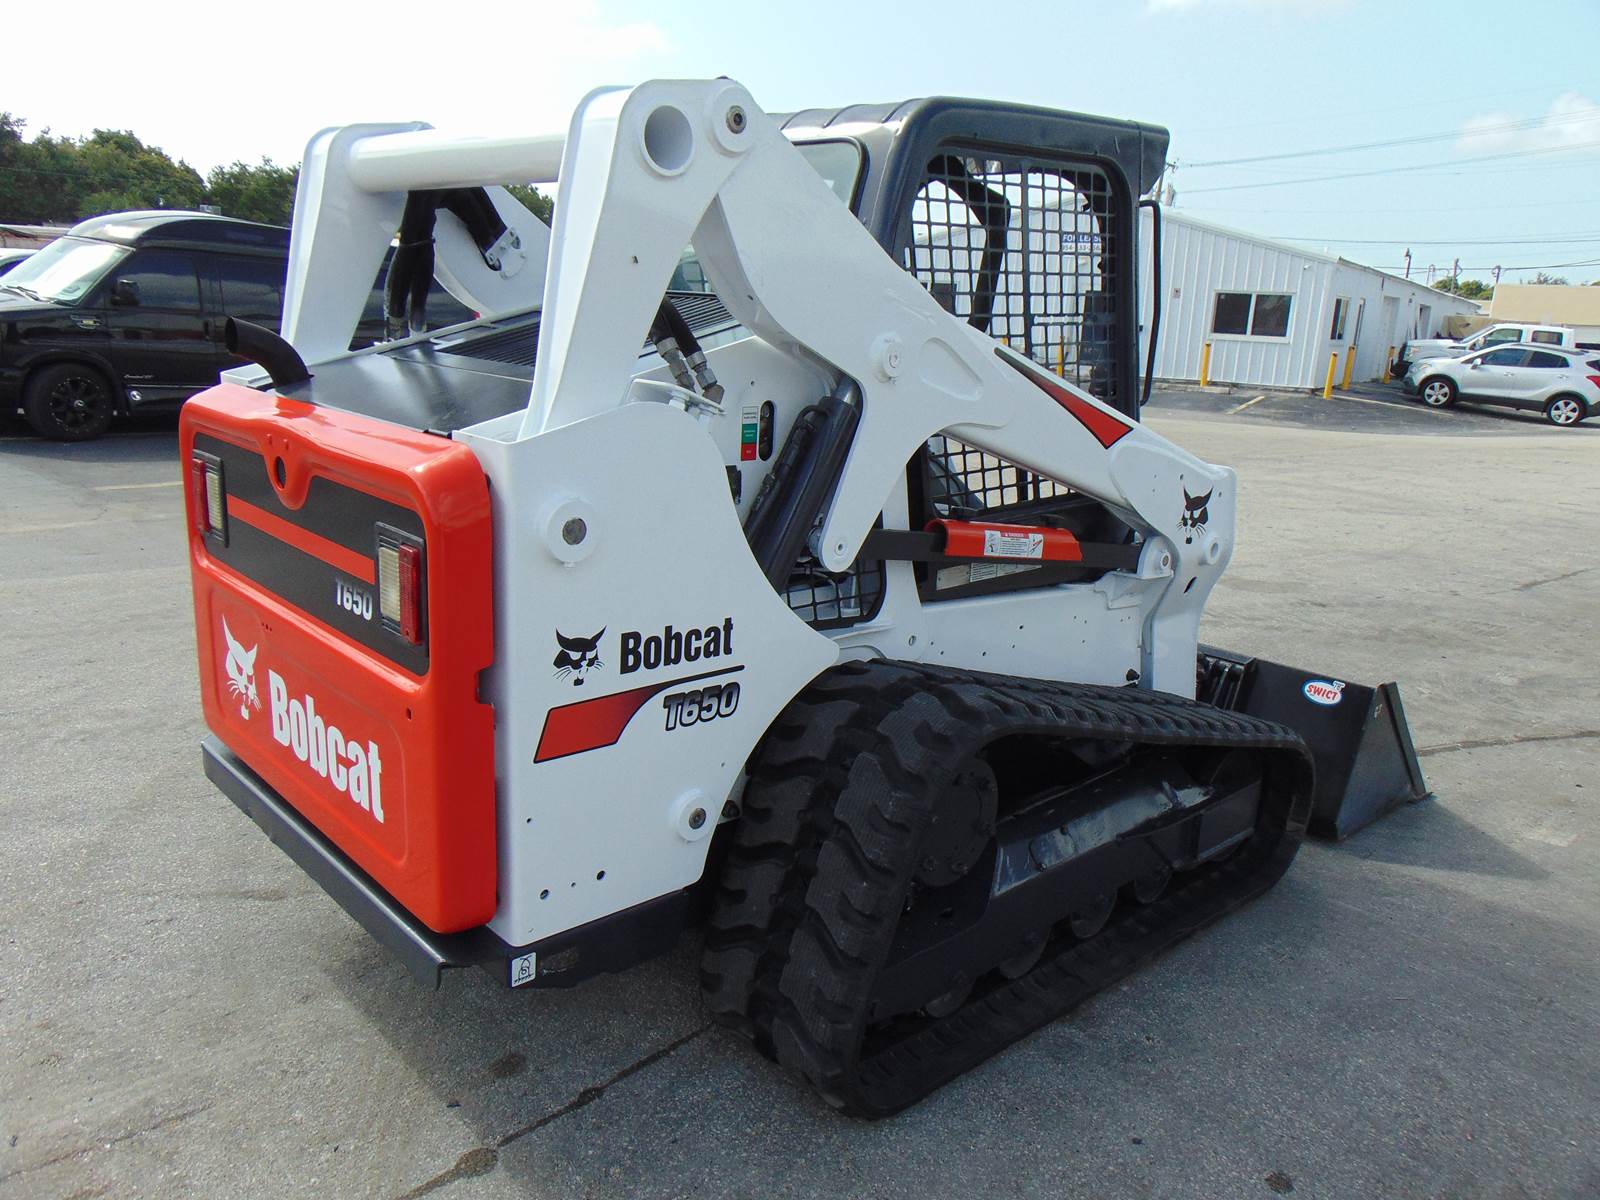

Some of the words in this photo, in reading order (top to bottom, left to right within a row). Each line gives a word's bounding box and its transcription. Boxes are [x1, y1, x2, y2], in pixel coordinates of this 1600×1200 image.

[335, 576, 373, 621] T650
[620, 617, 734, 675] Bobcat
[663, 682, 741, 732] T650
[268, 668, 385, 824] Bobcat
